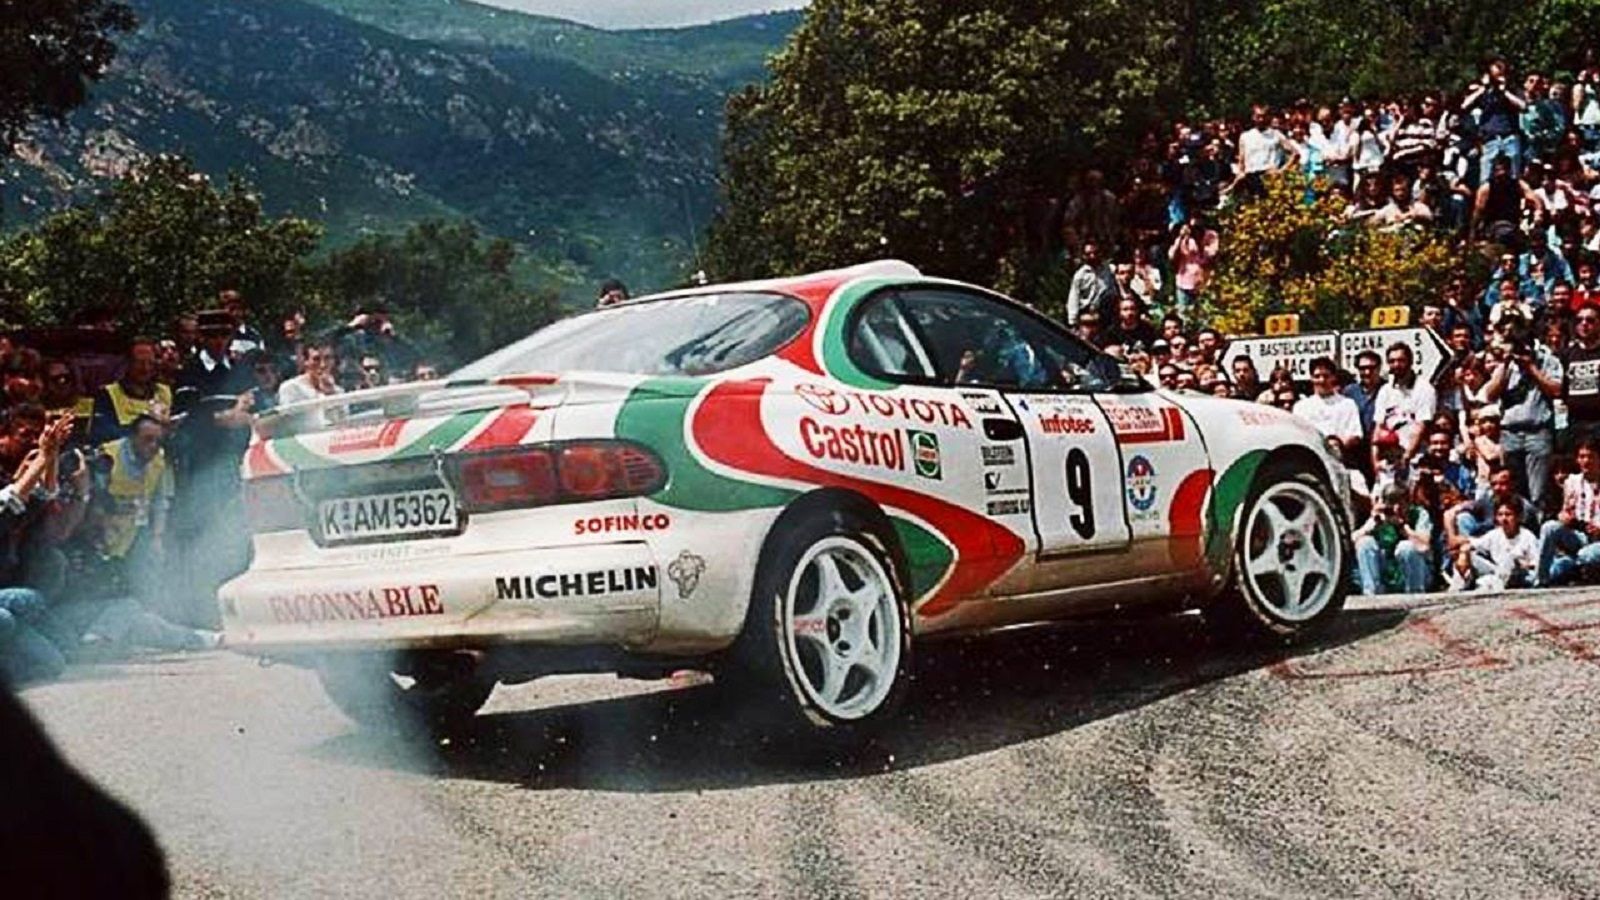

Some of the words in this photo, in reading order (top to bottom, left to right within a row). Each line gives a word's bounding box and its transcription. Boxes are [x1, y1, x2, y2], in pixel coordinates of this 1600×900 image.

[852, 392, 973, 430] TOYOTA
[1038, 413, 1096, 434] infotec
[799, 415, 906, 471] Castrol
[1064, 447, 1096, 540] 9
[574, 513, 670, 535] SOFINCO
[495, 565, 658, 600] MICHELIN
